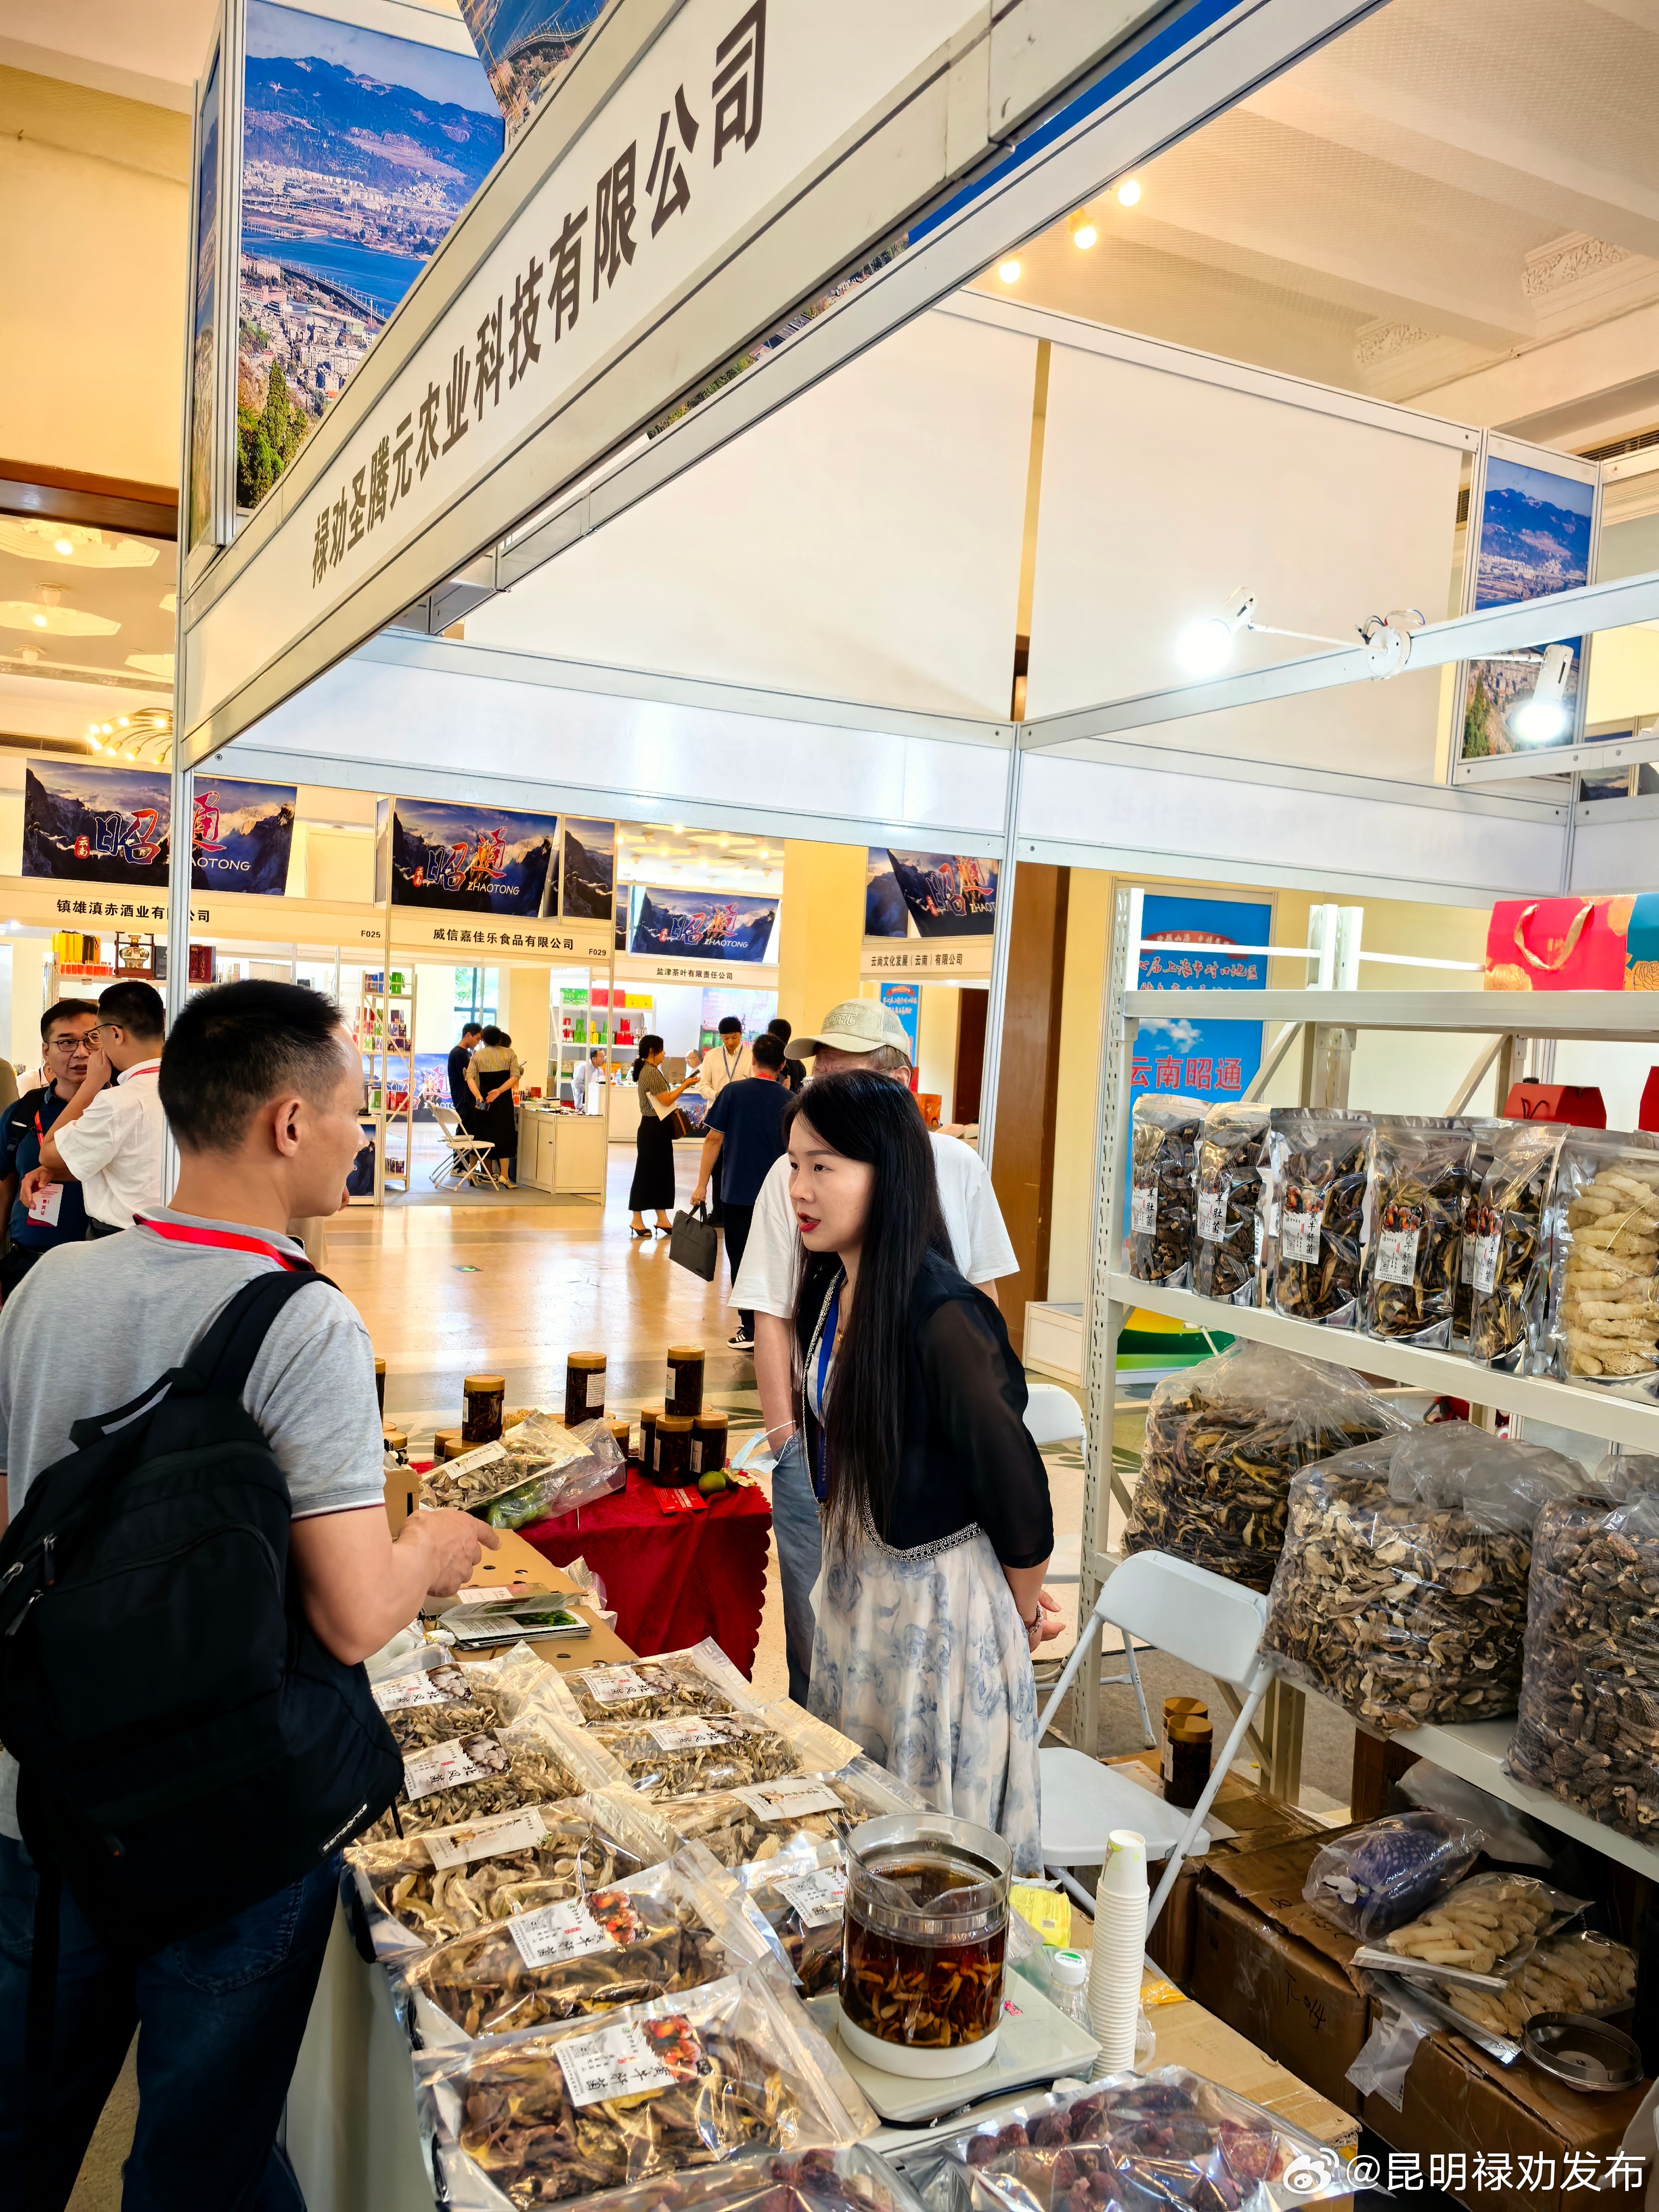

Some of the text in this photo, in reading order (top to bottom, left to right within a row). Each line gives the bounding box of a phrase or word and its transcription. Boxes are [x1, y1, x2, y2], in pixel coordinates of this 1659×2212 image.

[312, 0, 768, 589] 禄劝圣腾元农业科技有限公司
[427, 826, 508, 891] 昭通
[467, 882, 520, 895] ZHAOTONG
[56, 899, 210, 923] 镇雄滇赤酒业有司
[361, 930, 381, 938] F025
[670, 902, 739, 945] 昭通
[433, 928, 574, 950] 威信嘉佳乐食品有限公司
[704, 939, 749, 948] ZHAOTONG
[588, 948, 607, 956] F029
[656, 967, 733, 980] 盐津茶叶有限责任公司
[1130, 1055, 1242, 1091] 云南昭通
[1146, 1187, 1155, 1227] 羊肚菌
[1212, 1190, 1224, 1233] 羊肚菌
[1306, 1211, 1317, 1254] 黄牛肝菌
[429, 1765, 477, 1783] 北风菌
